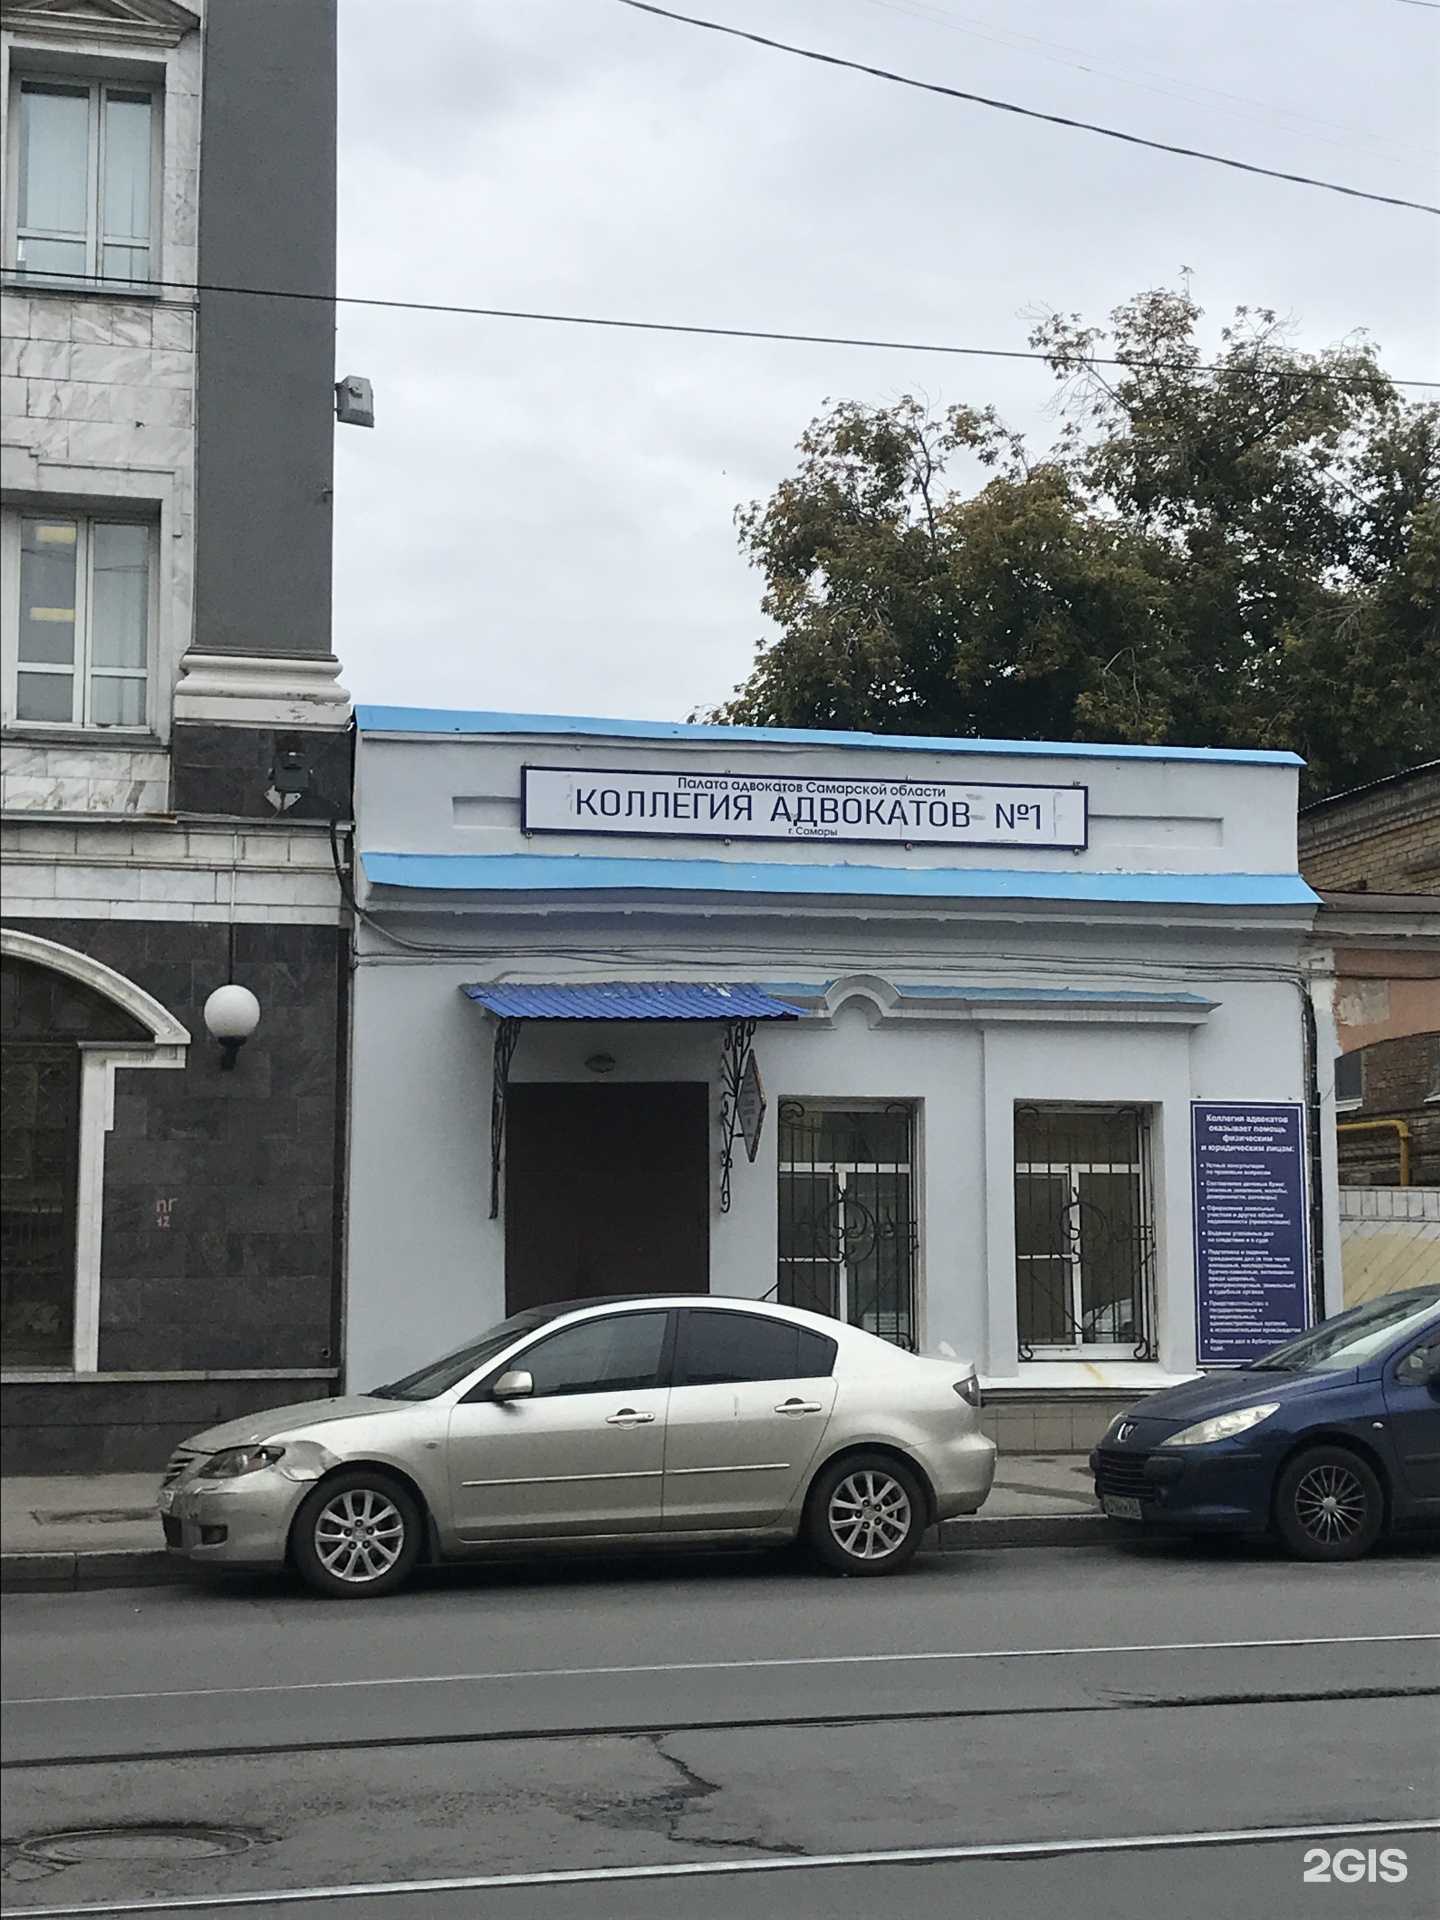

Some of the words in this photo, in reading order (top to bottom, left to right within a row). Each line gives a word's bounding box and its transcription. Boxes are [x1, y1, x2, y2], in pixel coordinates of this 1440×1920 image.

[678, 777, 728, 790] Палата
[731, 780, 803, 793] адвокатов
[806, 782, 887, 796] Самарской
[890, 785, 946, 797] области
[576, 788, 752, 820] КОЛЛЕГИЯ
[770, 796, 970, 828] АДВОКАТОВ
[996, 803, 1041, 830] №1
[795, 826, 838, 837] Самары
